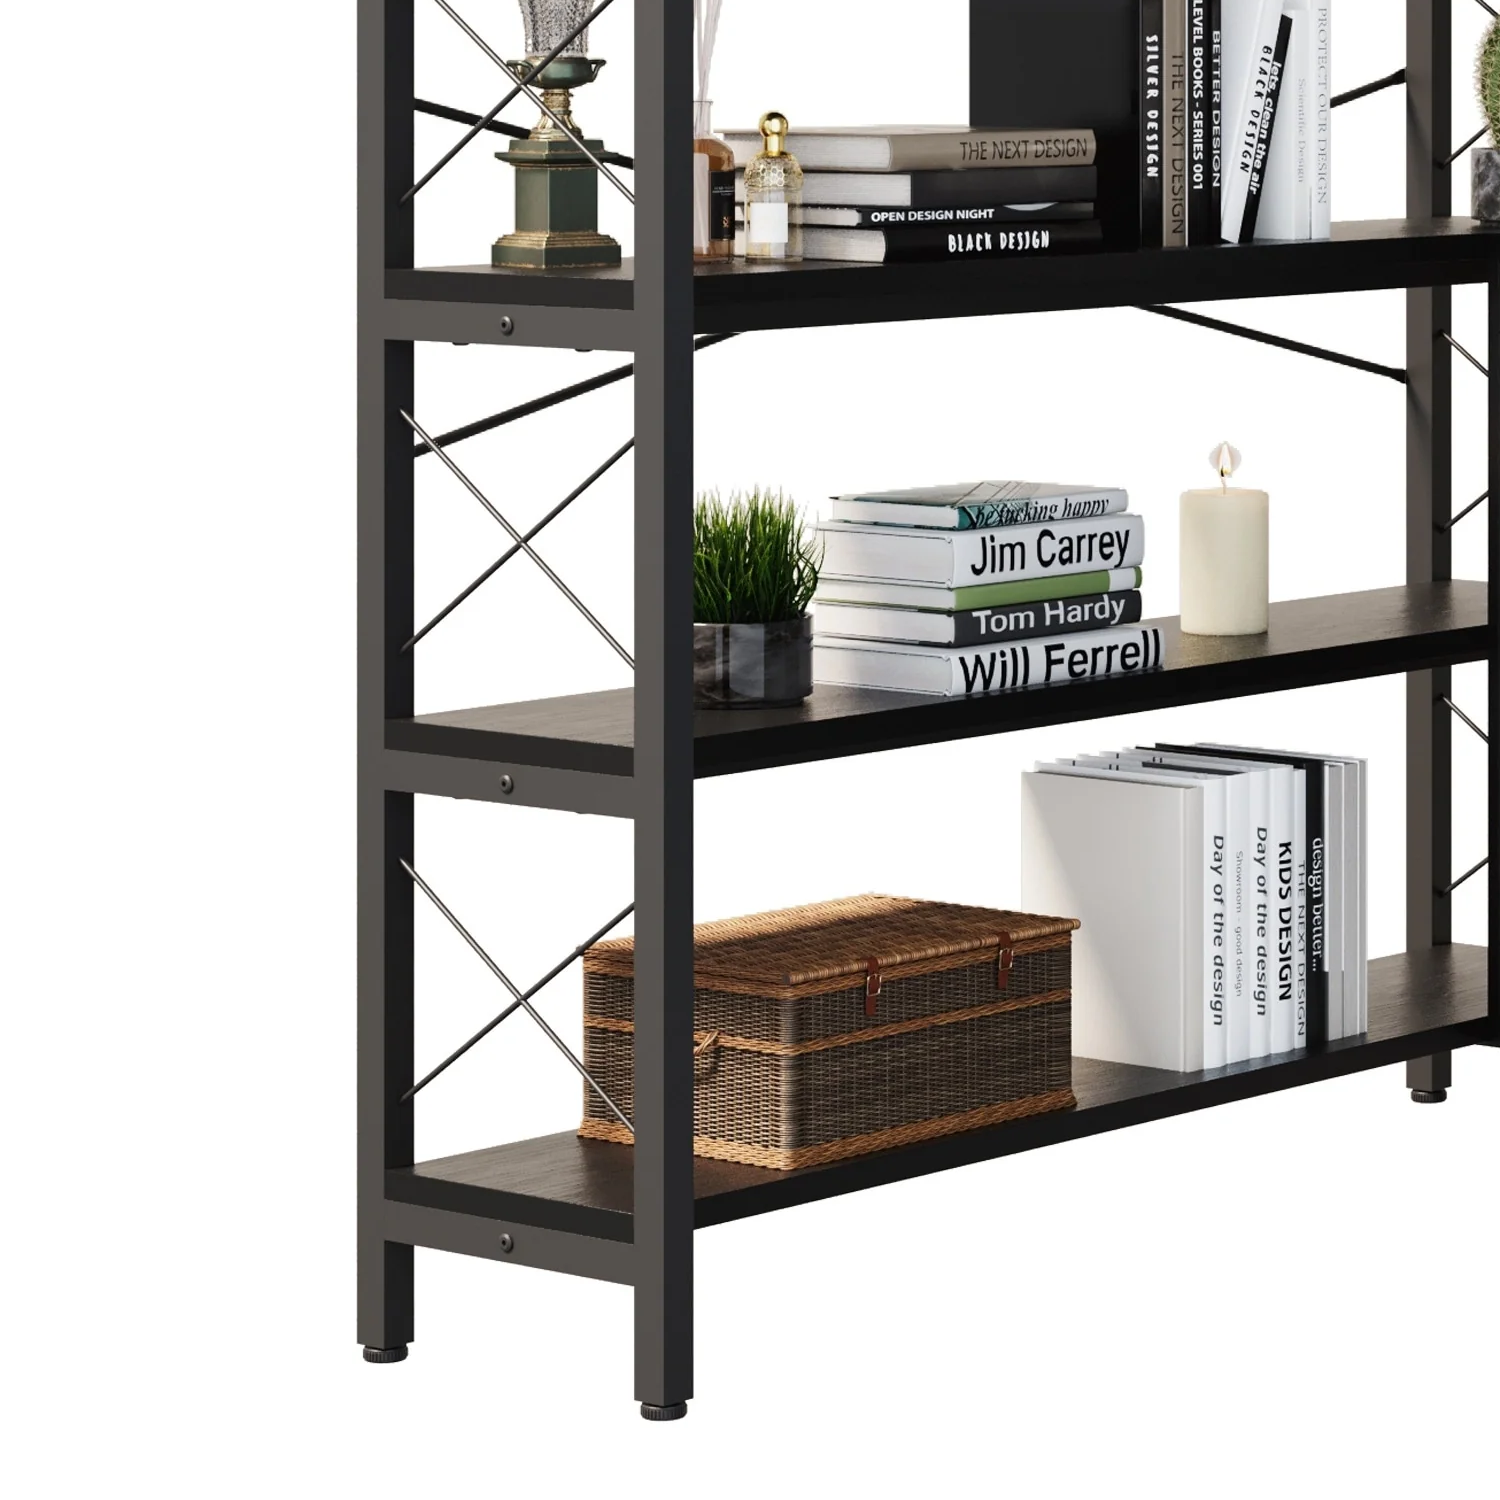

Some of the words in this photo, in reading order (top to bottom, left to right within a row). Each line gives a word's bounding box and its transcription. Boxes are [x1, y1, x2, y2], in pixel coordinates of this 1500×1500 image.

[1192, 0, 1204, 44] LEVEL
[1145, 34, 1160, 100] SILVER
[1171, 54, 1185, 92] THE
[1192, 46, 1204, 99] BOOKS
[1145, 109, 1159, 177] DESIGN
[1171, 98, 1185, 150] NEXT
[1192, 110, 1204, 161] SERIES
[959, 140, 988, 161] THE
[991, 139, 1030, 161] NEXT
[1033, 137, 1088, 159] DESIGN
[1171, 156, 1185, 236] DESIGN
[1192, 163, 1204, 190] 001
[870, 211, 906, 223] OPEN
[907, 209, 954, 222] DESIGN
[956, 208, 995, 220] NIGHT
[947, 231, 992, 253] BLACK
[999, 230, 1050, 251] DESIGN
[973, 504, 997, 529] be
[998, 499, 1059, 526] fucking
[1062, 496, 1110, 520] happy
[970, 534, 1026, 577] Jim
[1036, 529, 1131, 569] Carrey
[971, 609, 1035, 635] Tom
[1043, 594, 1127, 627] Hardy
[958, 646, 1030, 695] Will
[1043, 628, 1161, 683] Ferrell
[1209, 835, 1225, 877] Day
[1278, 841, 1292, 900] KIDS
[1307, 837, 1325, 899] design
[1213, 883, 1225, 905] of
[1213, 912, 1225, 948] the
[1278, 906, 1292, 1001] DESIGN
[1312, 902, 1325, 972] better...
[1209, 954, 1225, 1026] design
